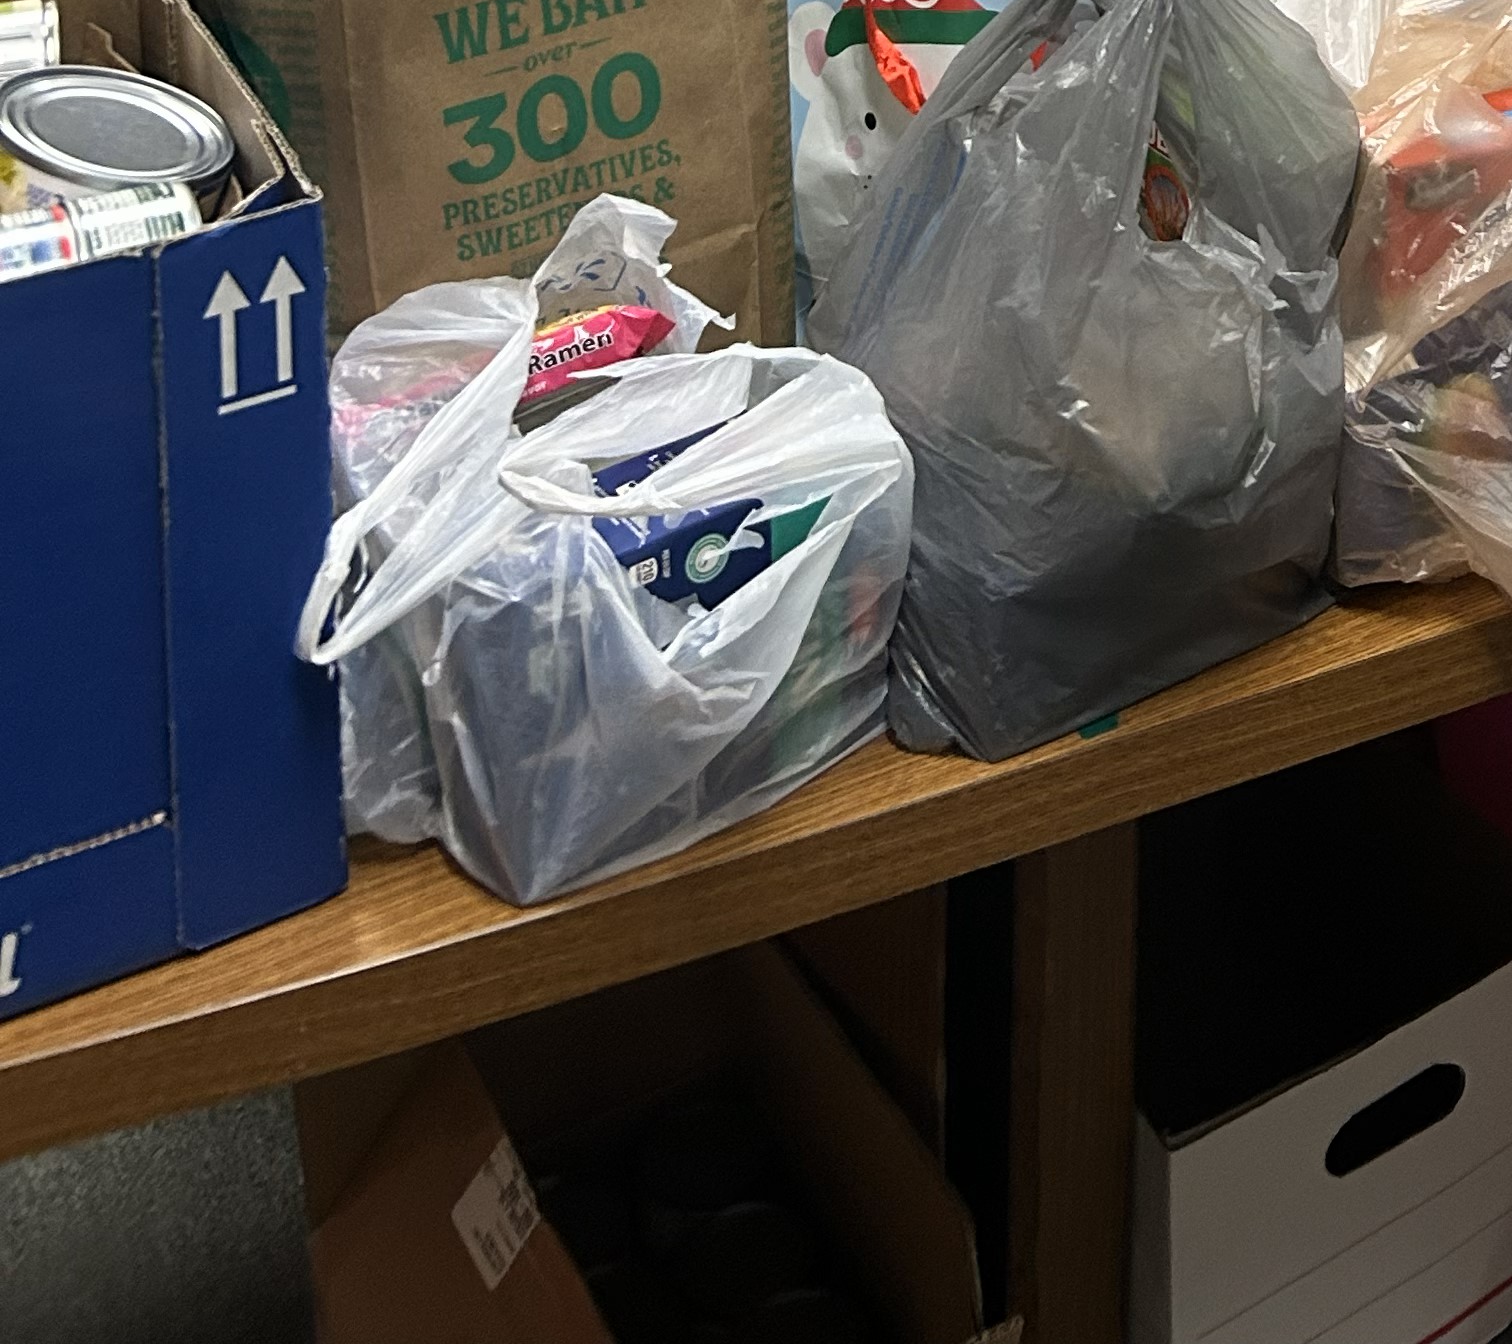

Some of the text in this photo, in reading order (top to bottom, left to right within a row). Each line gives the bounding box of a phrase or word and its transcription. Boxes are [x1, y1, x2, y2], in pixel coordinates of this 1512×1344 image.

[523, 42, 577, 73] over
[441, 52, 661, 185] 300
[441, 139, 682, 231] PRESERVATIVES,
[653, 176, 677, 207] &
[528, 331, 613, 376] Ramen
